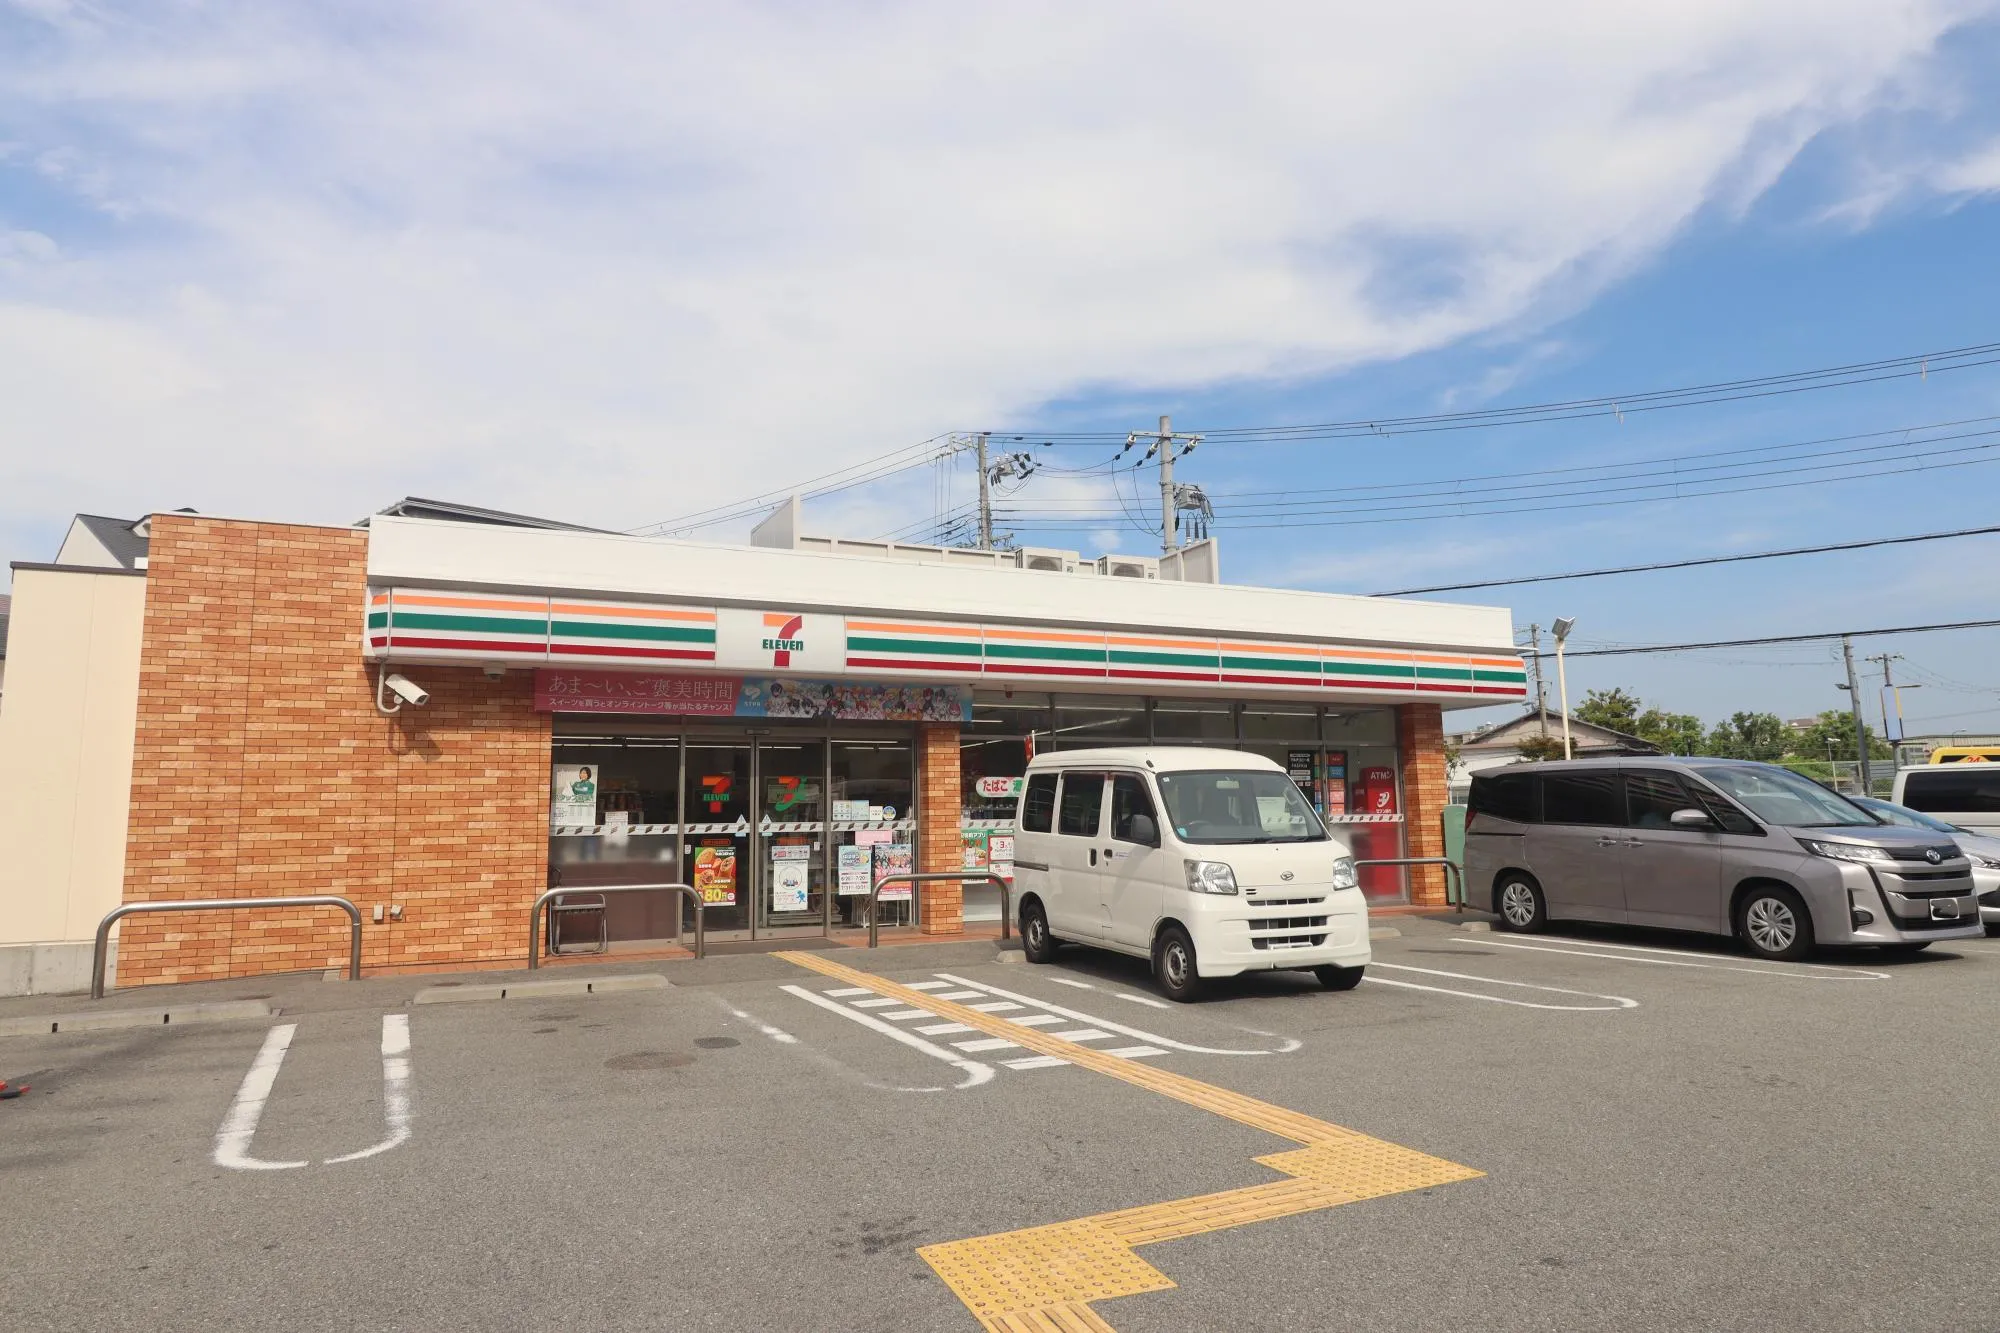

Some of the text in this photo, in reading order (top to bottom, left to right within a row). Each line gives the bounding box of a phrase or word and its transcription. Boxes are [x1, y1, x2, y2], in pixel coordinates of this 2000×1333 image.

[763, 614, 802, 667] 7
[1370, 771, 1387, 780] ATM
[983, 780, 1008, 792] たばこ
